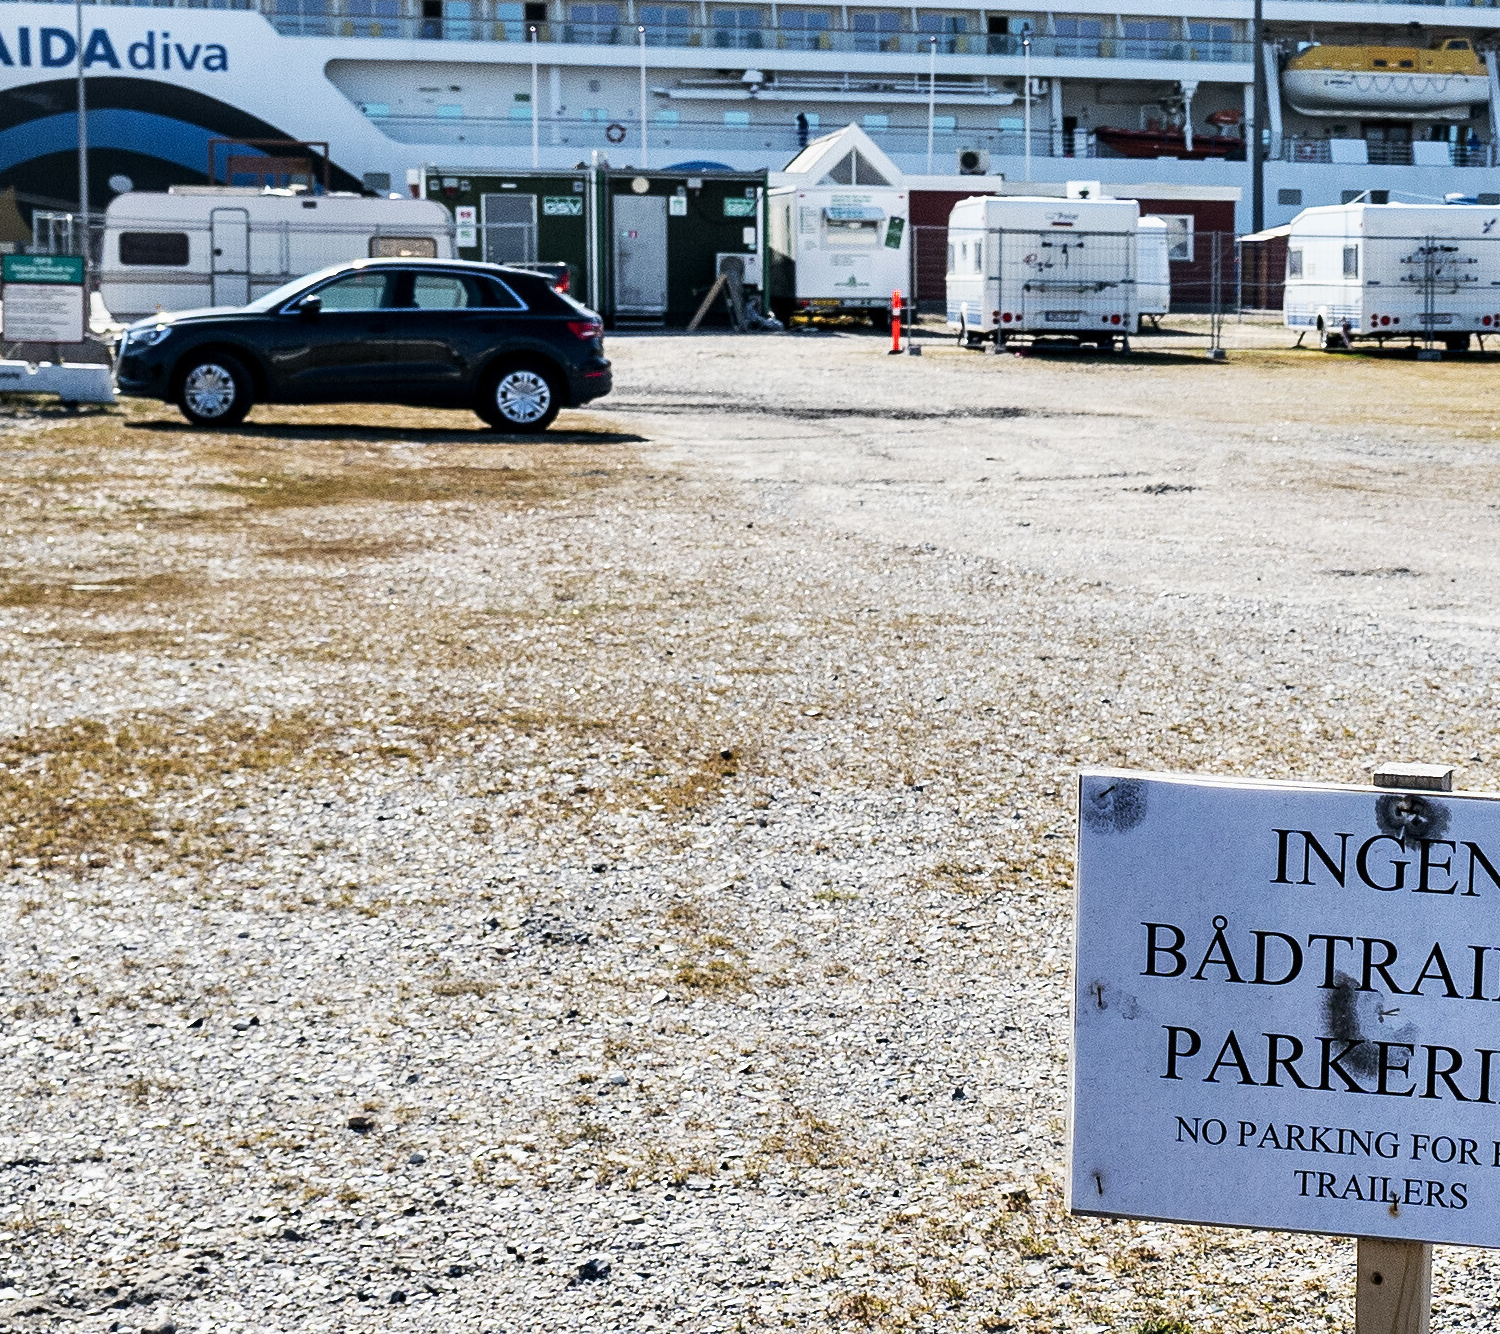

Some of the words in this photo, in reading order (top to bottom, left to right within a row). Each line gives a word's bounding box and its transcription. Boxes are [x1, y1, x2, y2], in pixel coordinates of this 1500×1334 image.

[1174, 1115, 1228, 1146] NO
[1236, 1120, 1401, 1159] PARKING
[1409, 1133, 1483, 1166] FOR
[1293, 1169, 1468, 1210] TRAILERS
